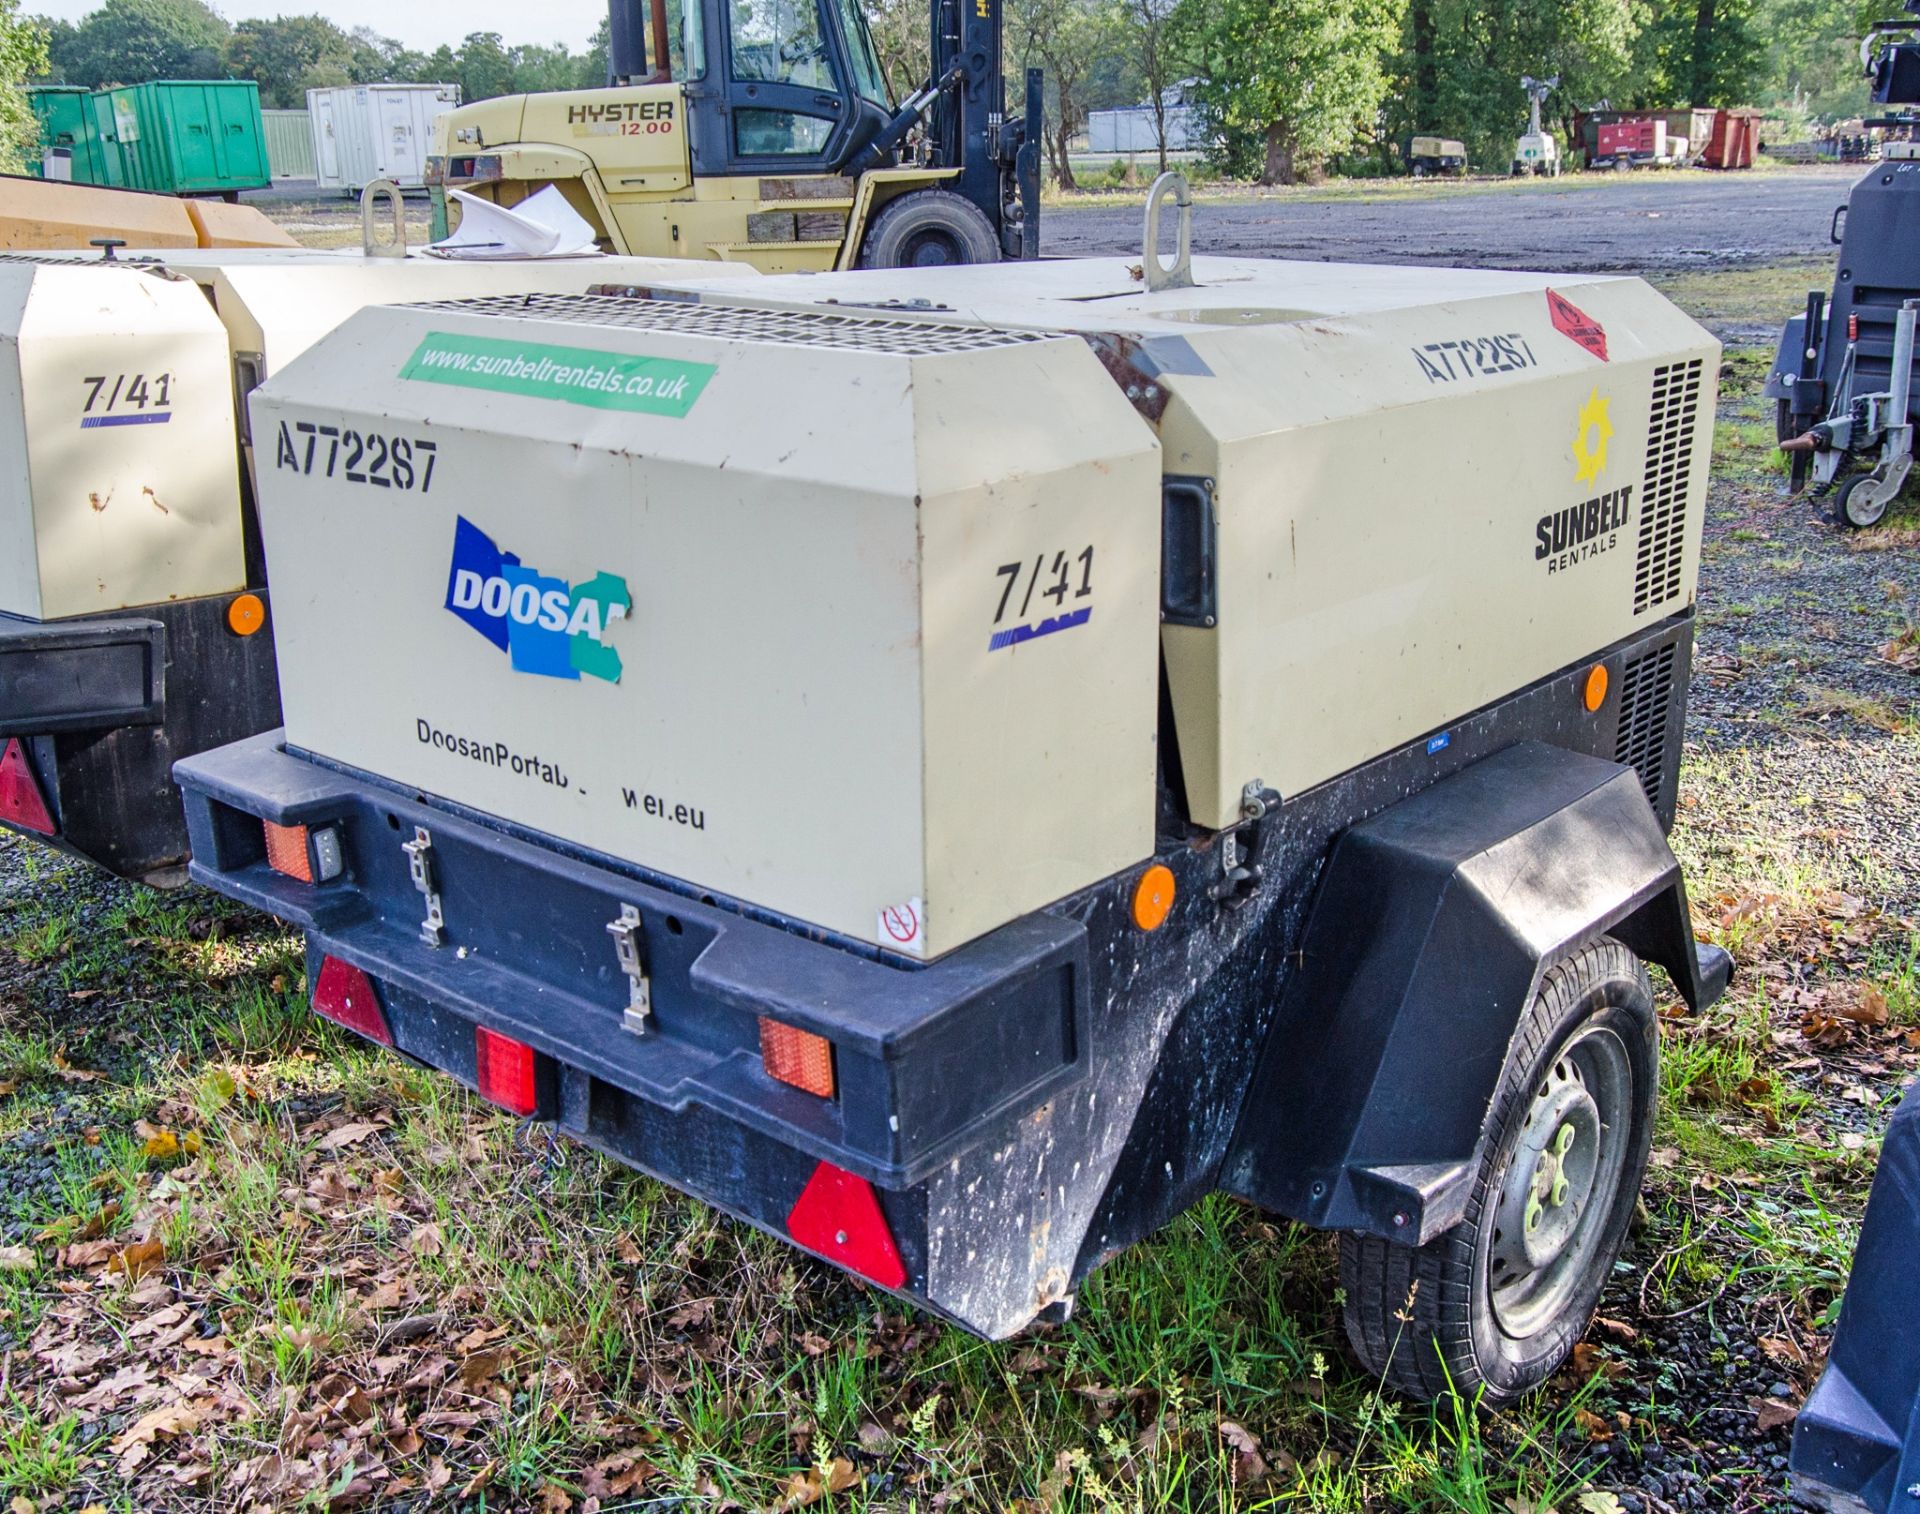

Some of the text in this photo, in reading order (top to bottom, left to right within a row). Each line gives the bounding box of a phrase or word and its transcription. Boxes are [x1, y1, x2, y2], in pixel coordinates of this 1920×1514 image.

[568, 102, 674, 124] HYSTER
[621, 121, 673, 136] 12.00
[83, 373, 170, 413] 7/41
[421, 348, 690, 400] www.sunbeltrentals.co.uk
[1535, 485, 1633, 561] SUNBELT
[1548, 533, 1617, 576] RENTALS
[993, 544, 1094, 625] 7/41
